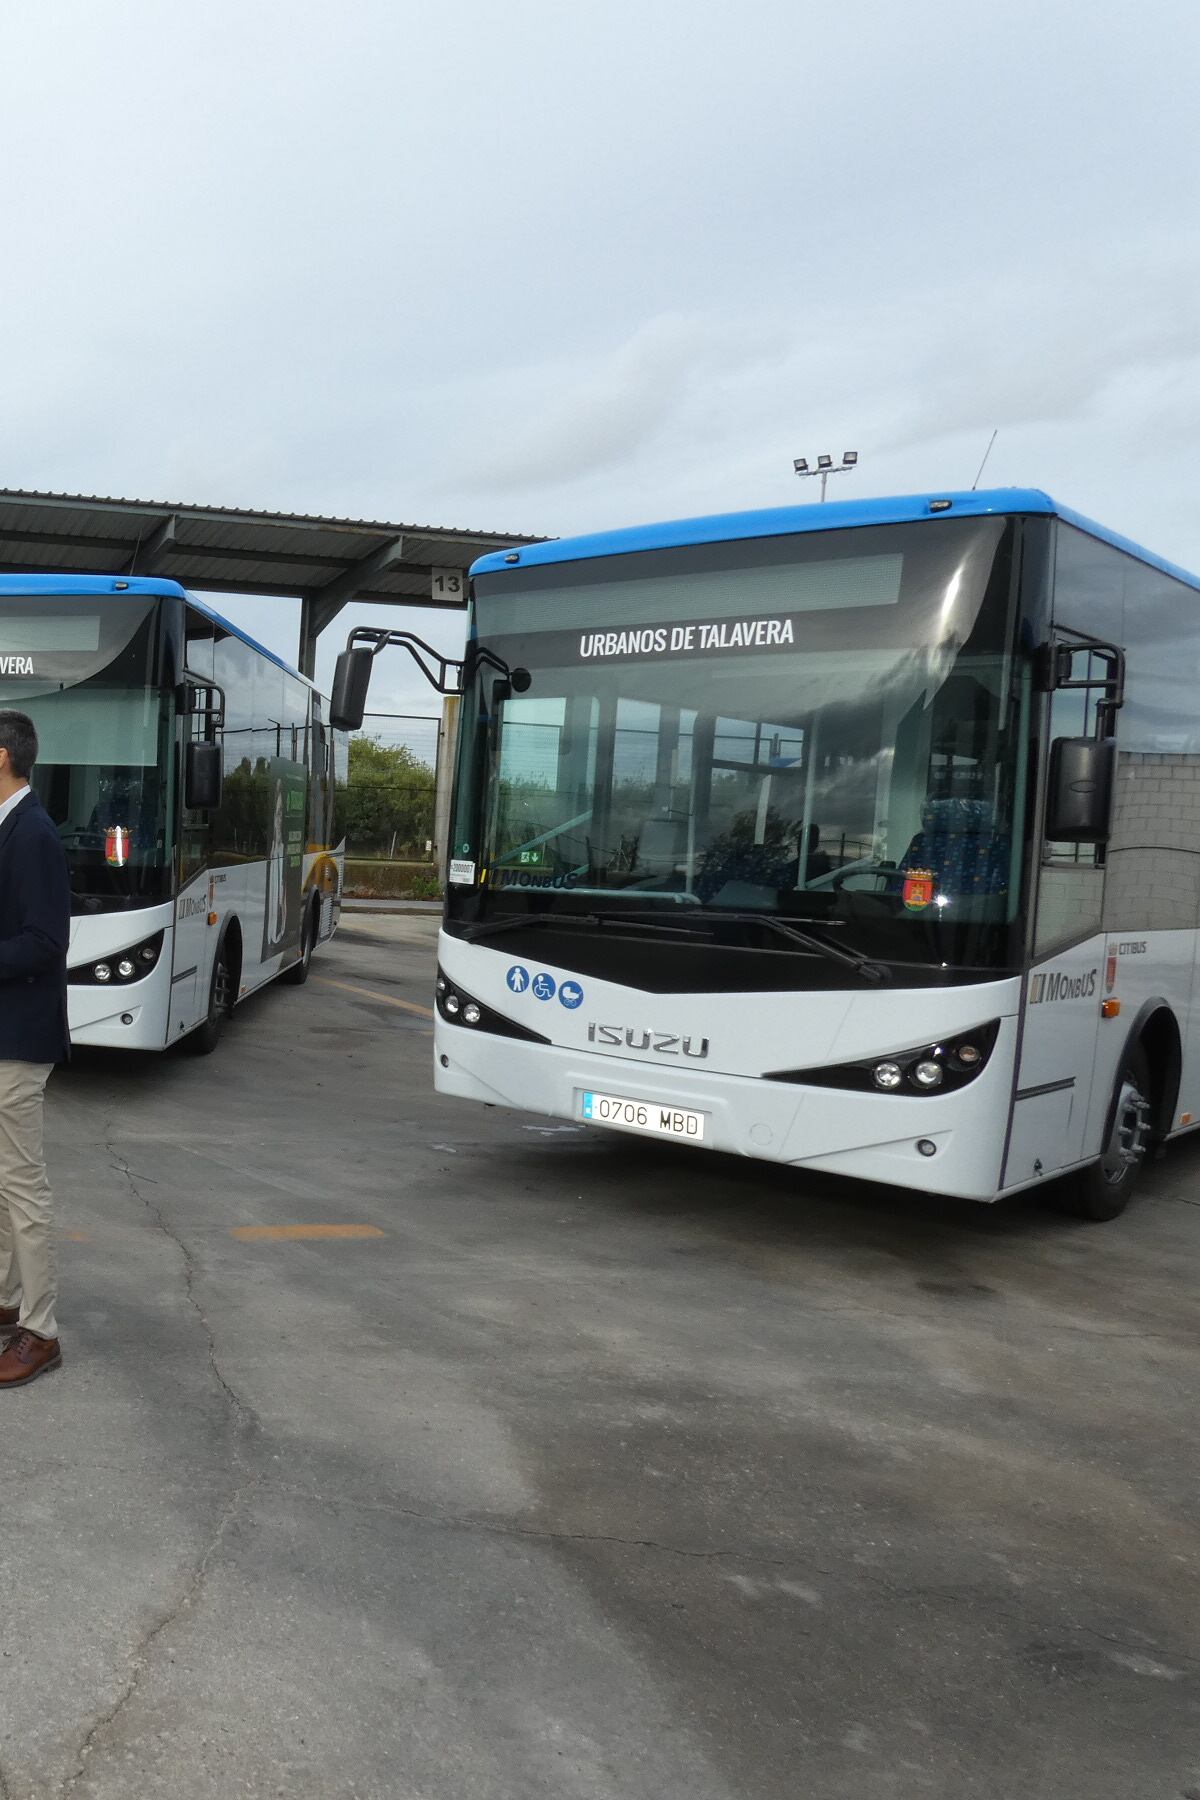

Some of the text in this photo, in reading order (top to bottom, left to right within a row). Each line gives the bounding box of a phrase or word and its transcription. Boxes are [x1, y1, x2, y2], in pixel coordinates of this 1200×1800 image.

[434, 575, 461, 593] 13
[579, 619, 795, 658] URBANOS DE TALAVERA
[1118, 941, 1147, 955] CITIBUS
[587, 1021, 710, 1059] ISUZU
[599, 1099, 699, 1135] 0706 MBD
